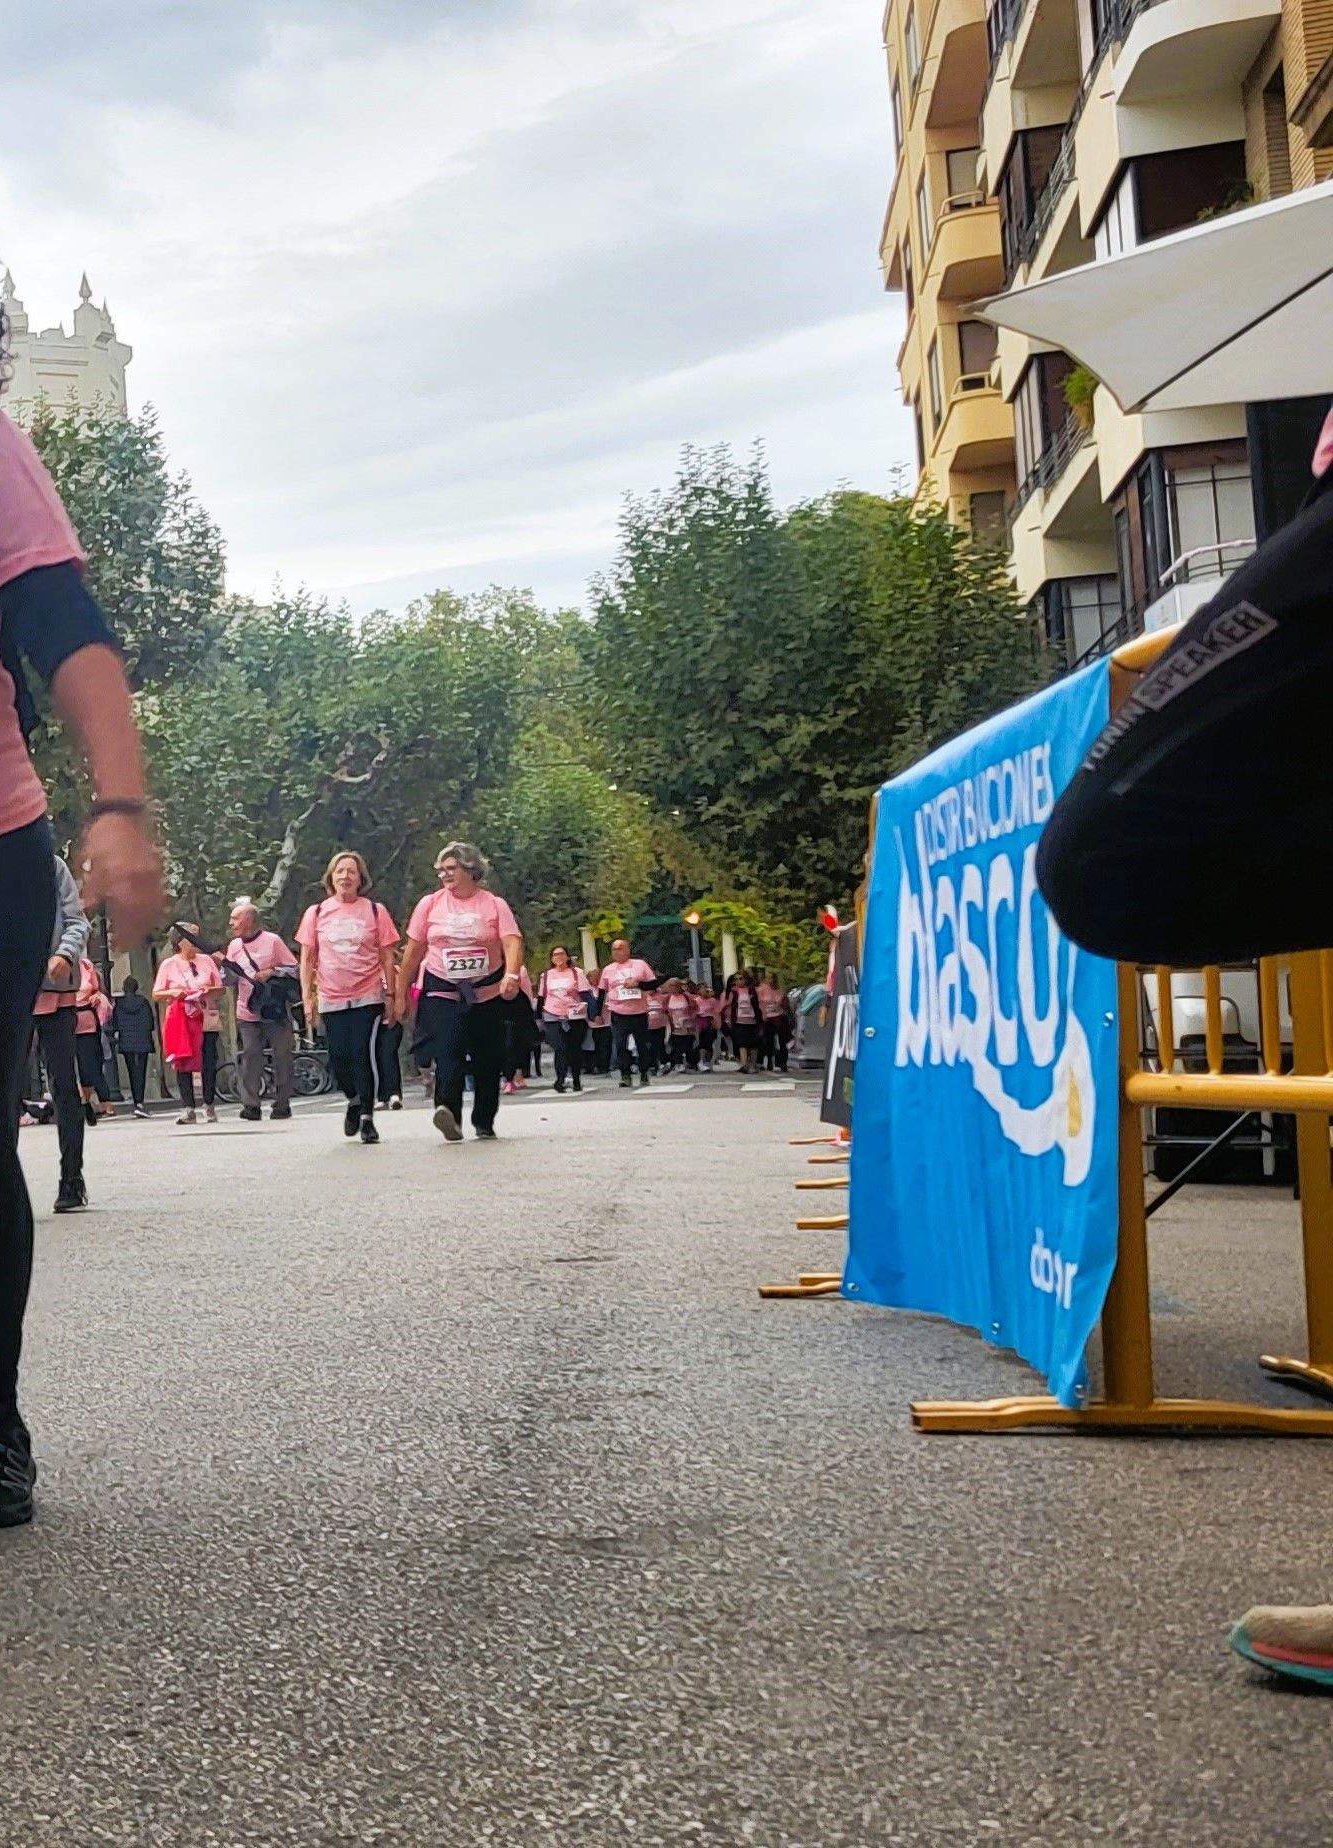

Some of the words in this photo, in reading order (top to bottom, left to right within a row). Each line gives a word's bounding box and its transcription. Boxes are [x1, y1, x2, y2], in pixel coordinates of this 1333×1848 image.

[1139, 609, 1270, 703] SPEAKER
[448, 957, 485, 972] 2327
[894, 810, 1063, 1068] blasco
